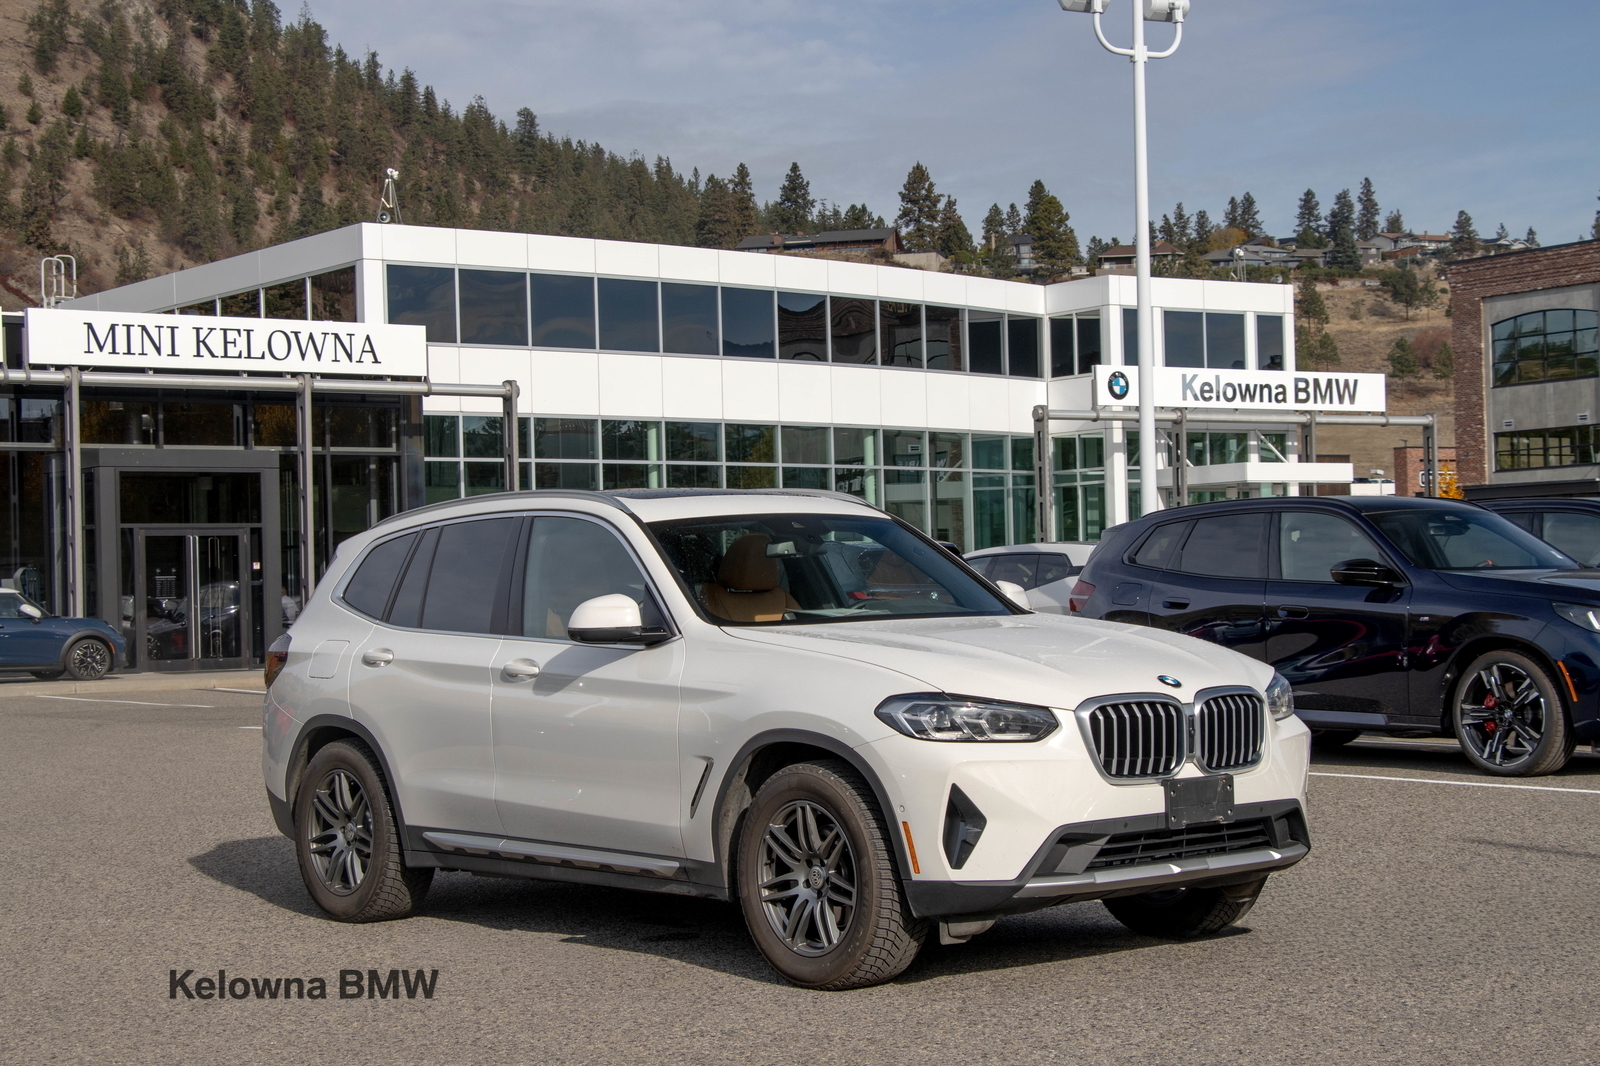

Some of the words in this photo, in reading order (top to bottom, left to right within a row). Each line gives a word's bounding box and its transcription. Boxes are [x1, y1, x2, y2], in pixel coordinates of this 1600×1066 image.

[83, 322, 181, 358] MINI
[192, 326, 382, 364] KELOWNA
[1181, 373, 1288, 405] Kelowna
[1293, 376, 1359, 406] BMW
